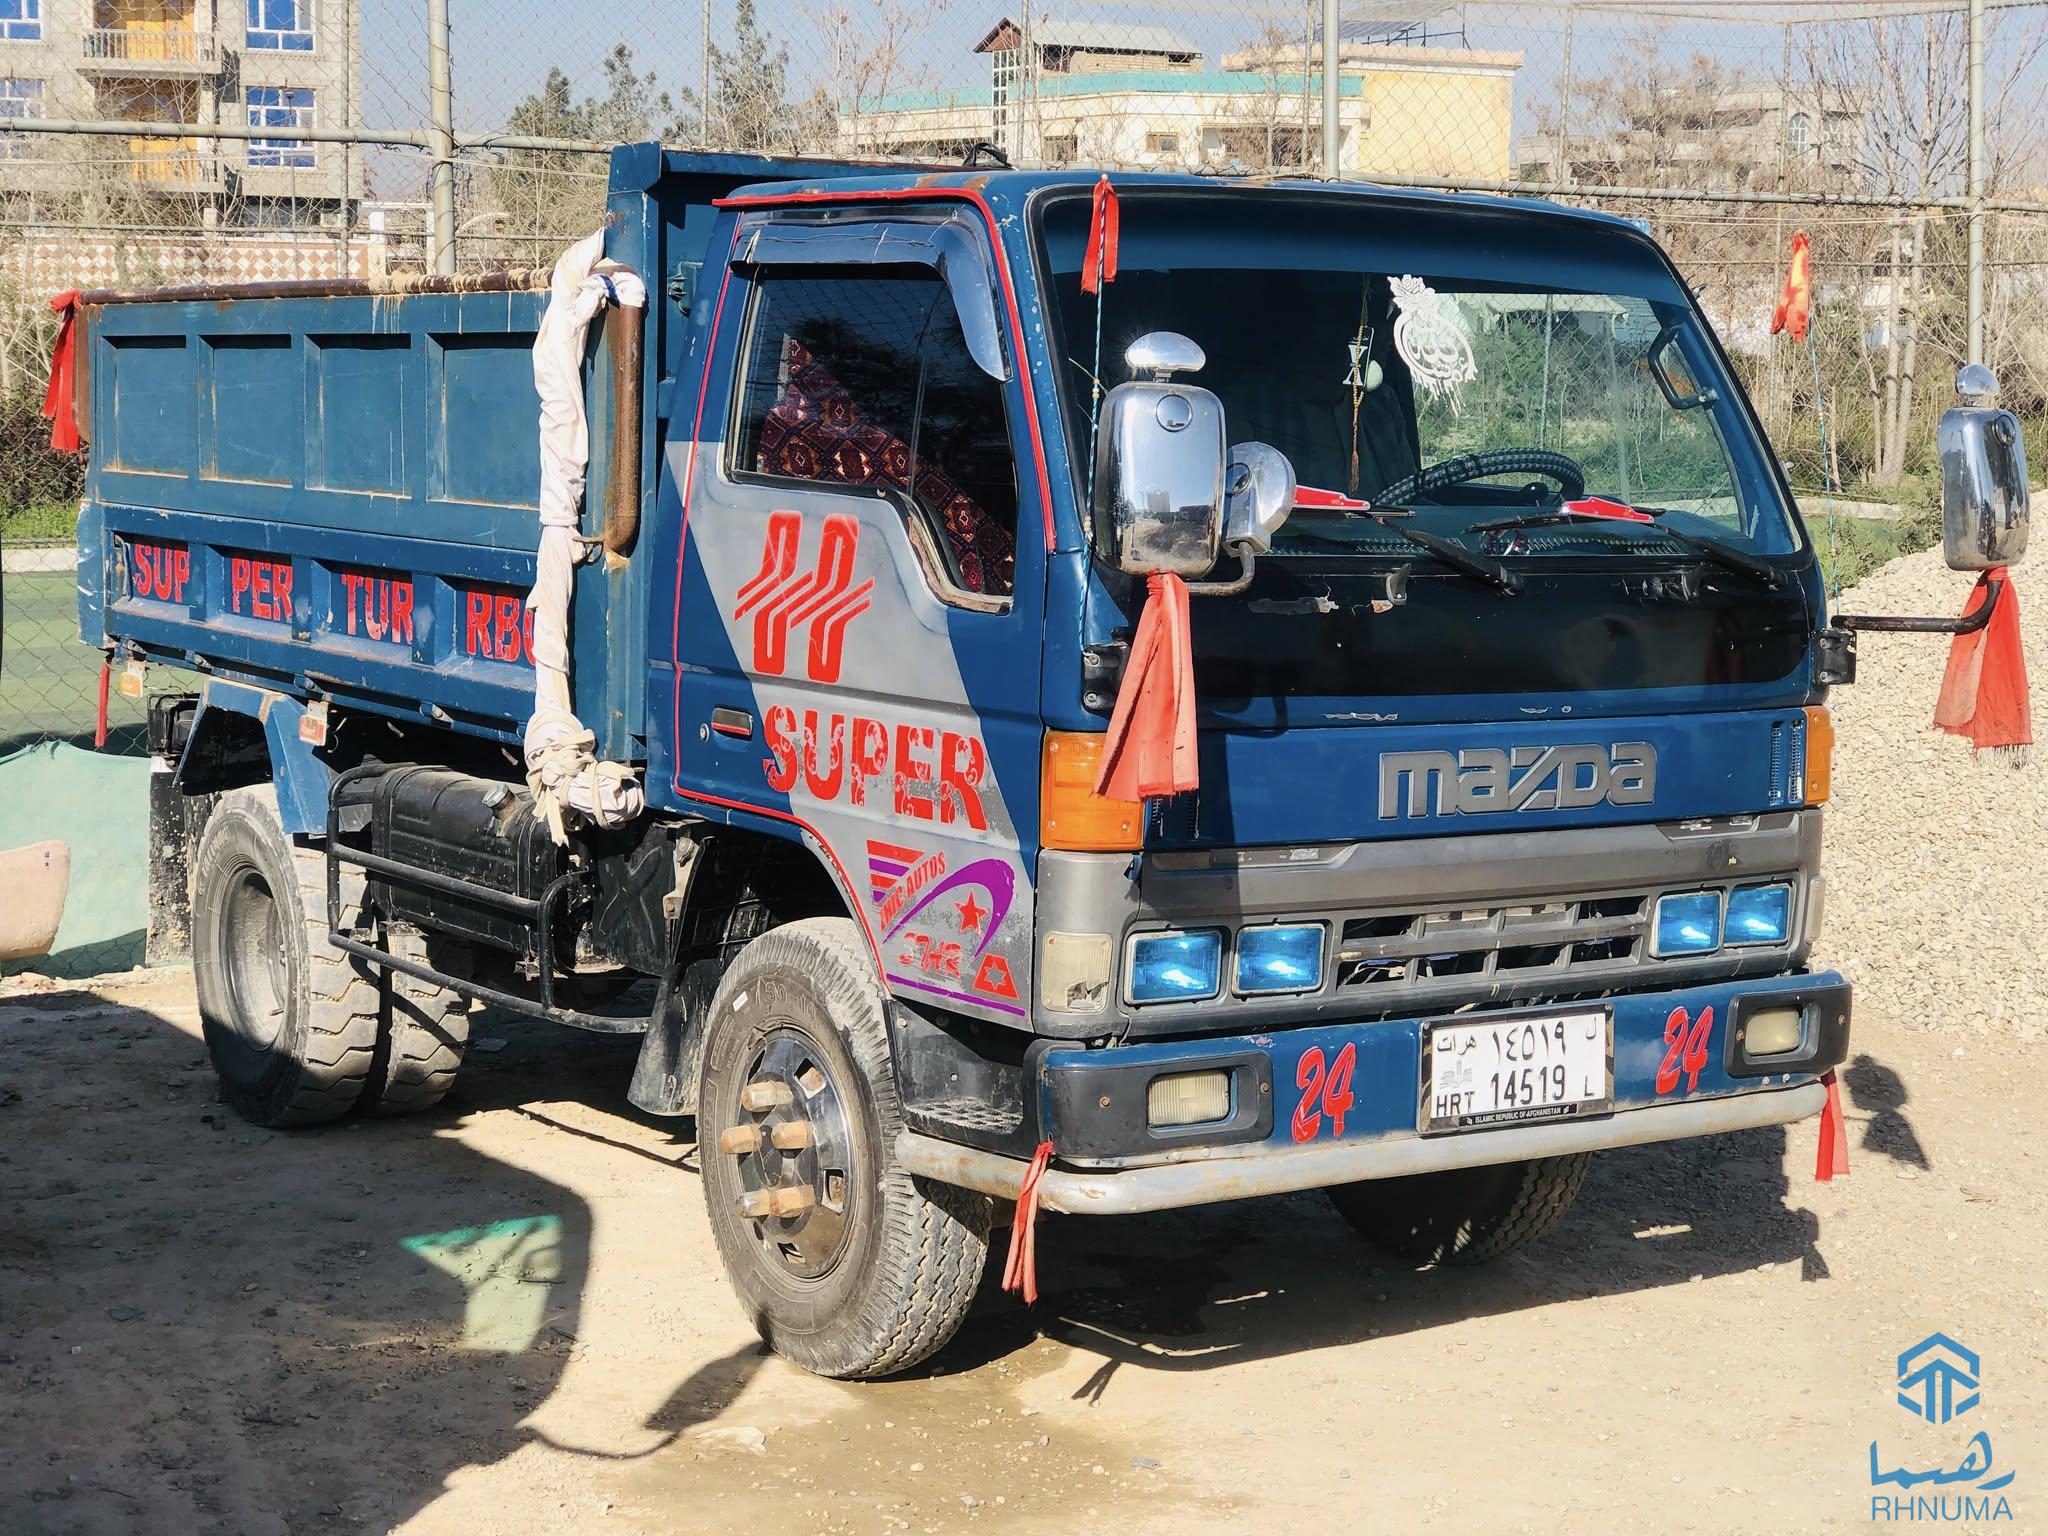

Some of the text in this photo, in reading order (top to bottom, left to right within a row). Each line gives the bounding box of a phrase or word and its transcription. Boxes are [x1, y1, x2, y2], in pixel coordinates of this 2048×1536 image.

[134, 542, 190, 604] SUP
[231, 556, 294, 622] PER
[341, 569, 414, 644] TUR
[762, 704, 987, 832] SUPER
[906, 851, 946, 897] AUTOS
[1291, 1042, 1356, 1144] 24
[1436, 1064, 1594, 1117] HRT 14519 L
[1656, 1006, 1715, 1095] 24
[1475, 1114, 1495, 1124] ISLAMIC
[1495, 1111, 1519, 1121] REPUBLIC
[1527, 1106, 1561, 1118] AFGHANISTAN
